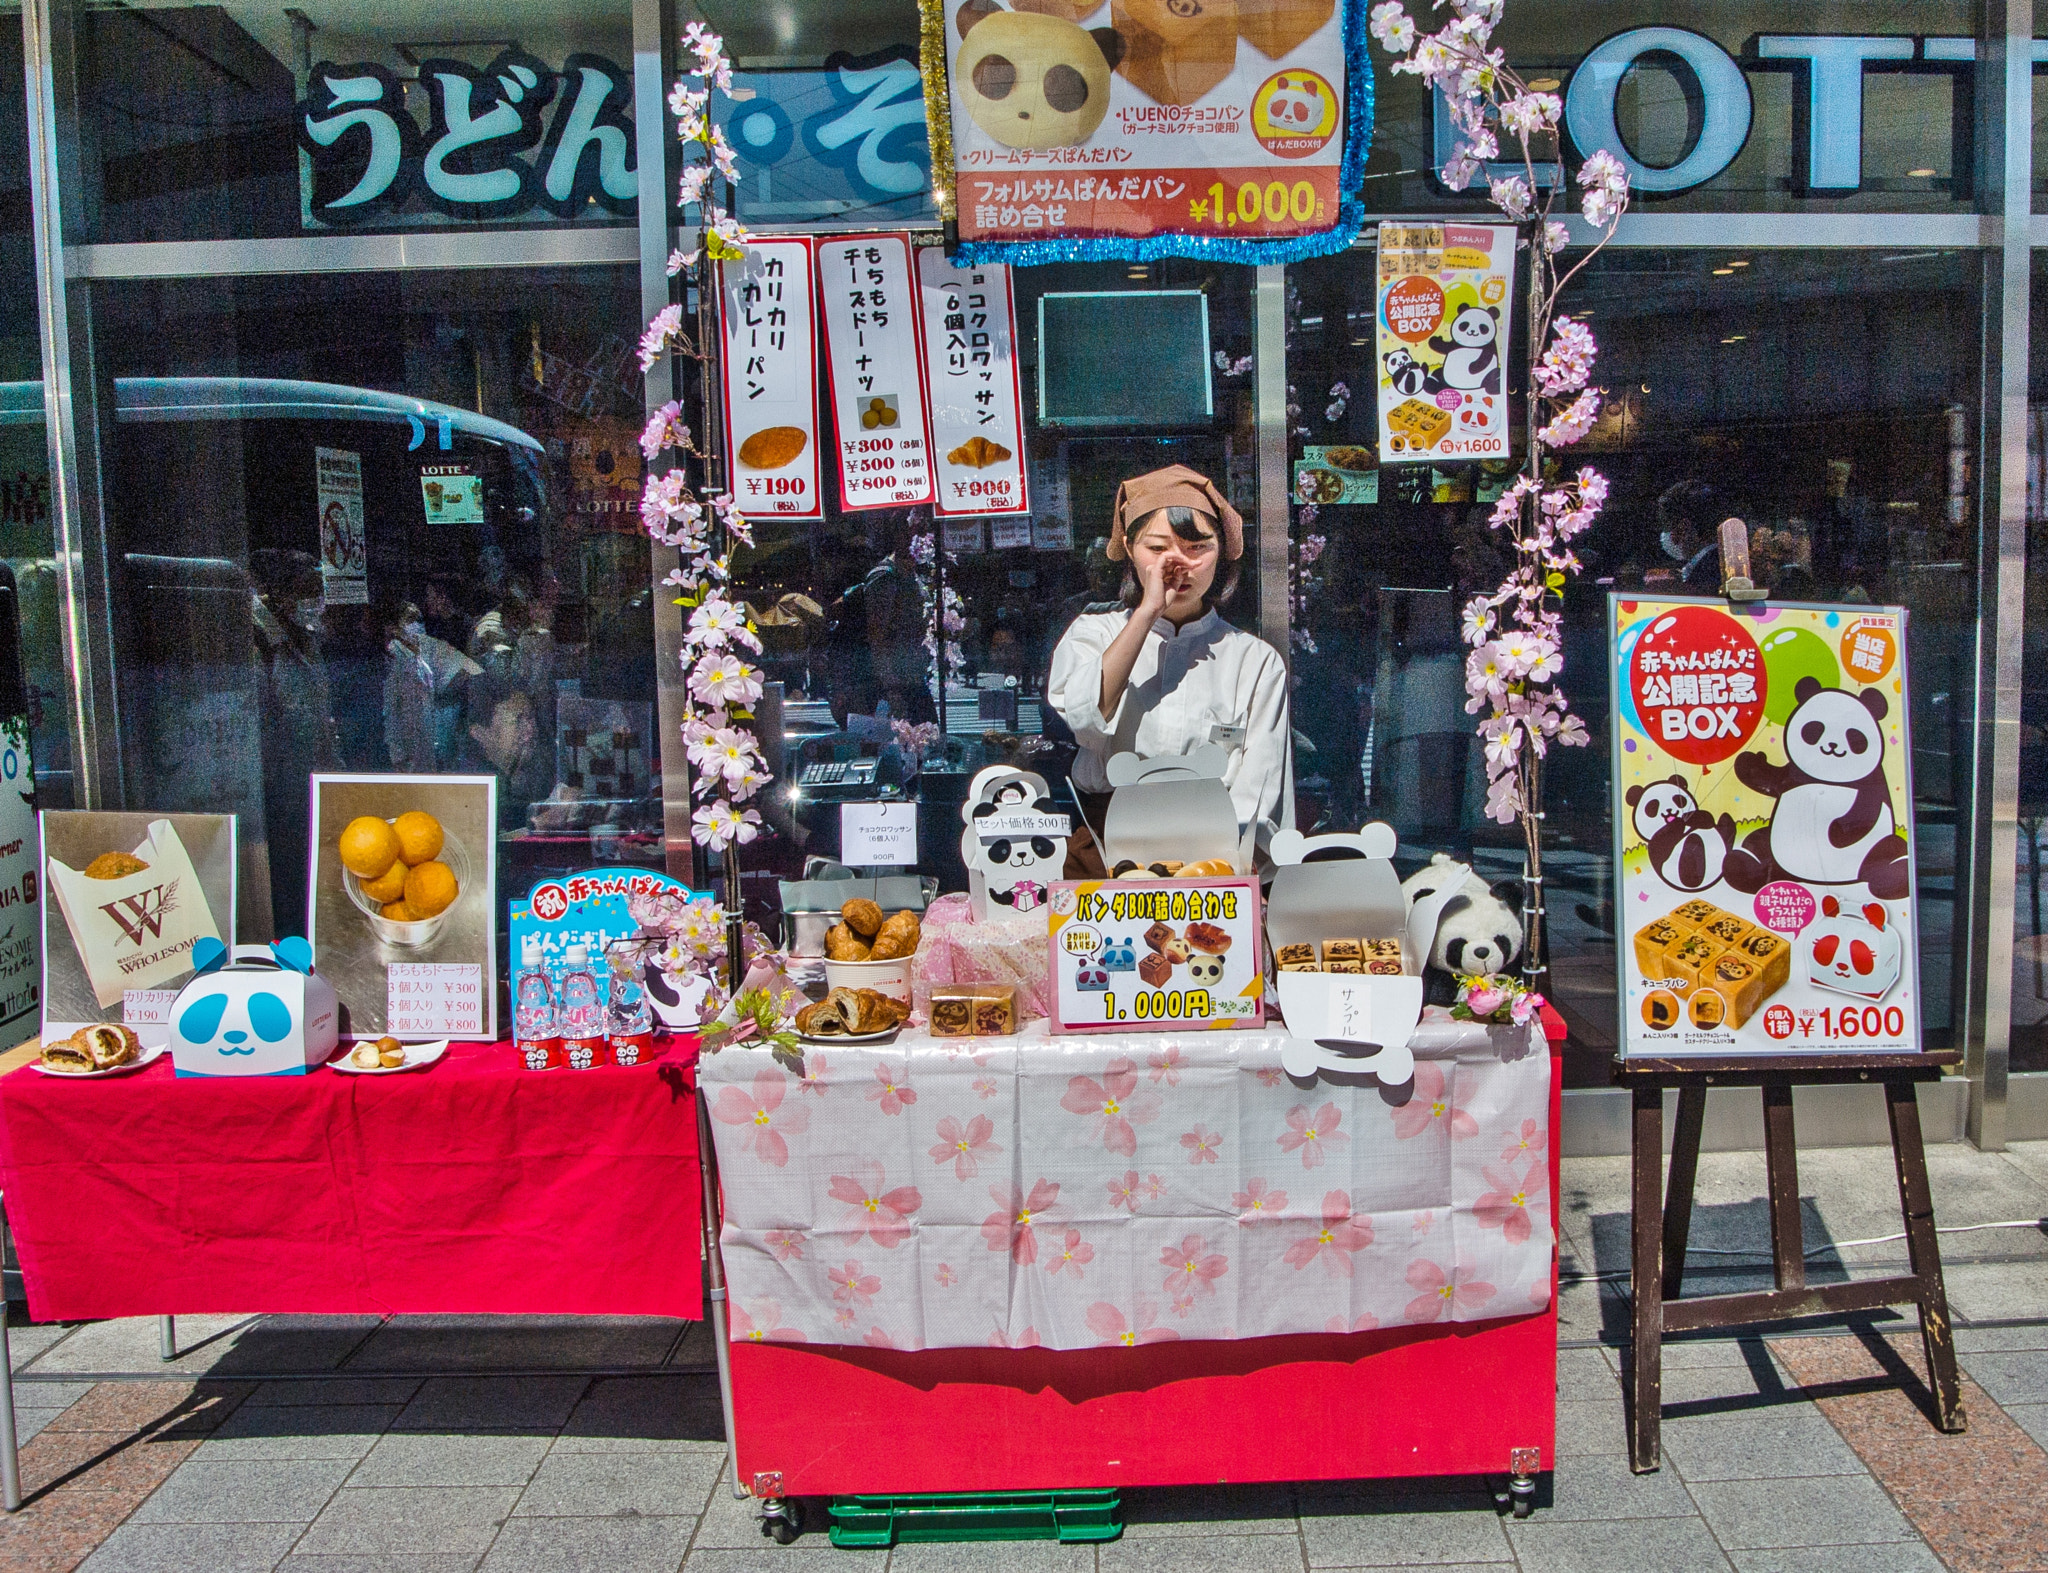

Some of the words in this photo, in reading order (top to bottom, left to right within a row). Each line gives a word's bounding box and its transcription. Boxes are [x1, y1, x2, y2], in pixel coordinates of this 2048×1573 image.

[306, 65, 640, 208] うどん
[974, 176, 1186, 203] フォルサムぱんだパン
[1190, 180, 1315, 227] ¥1,000
[974, 203, 1067, 228] 詰め合せ
[865, 247, 889, 328] もちもち
[765, 257, 785, 351] カリカリ
[1390, 303, 1440, 319] 公開記念
[1398, 317, 1432, 333] BOX
[743, 282, 766, 400] カレーパン
[844, 437, 893, 455] ¥300
[422, 466, 463, 475] LOTTE
[846, 456, 895, 473] ¥500
[746, 477, 805, 495] ¥190
[847, 475, 897, 492] ¥800
[953, 480, 1011, 498] ¥900
[1854, 632, 1887, 656] 当店
[1640, 648, 1756, 673] 赤ちゃんぱんだ
[1851, 653, 1883, 674] 限定
[1641, 672, 1757, 707] 公開記念
[1661, 705, 1742, 741] BOX
[858, 826, 912, 834] チョコクロワッサン
[868, 835, 899, 843] (6個入り)
[872, 853, 895, 861] 900円
[536, 889, 566, 917] 祝
[1077, 890, 1237, 922] パンダBOX詰め合わせ
[1066, 932, 1091, 941] かわいい
[388, 964, 480, 976] もちもちドーナツ
[444, 982, 476, 993] ¥300
[444, 1000, 476, 1011] ¥500
[1104, 989, 1211, 1020] 1,000円
[1341, 988, 1359, 1037] サンプル
[125, 1009, 158, 1021] ¥190
[444, 1018, 476, 1030] ¥800
[1767, 1010, 1791, 1020] 6個入
[1798, 1006, 1904, 1039] ¥1,600
[1768, 1020, 1790, 1034] 1箱
